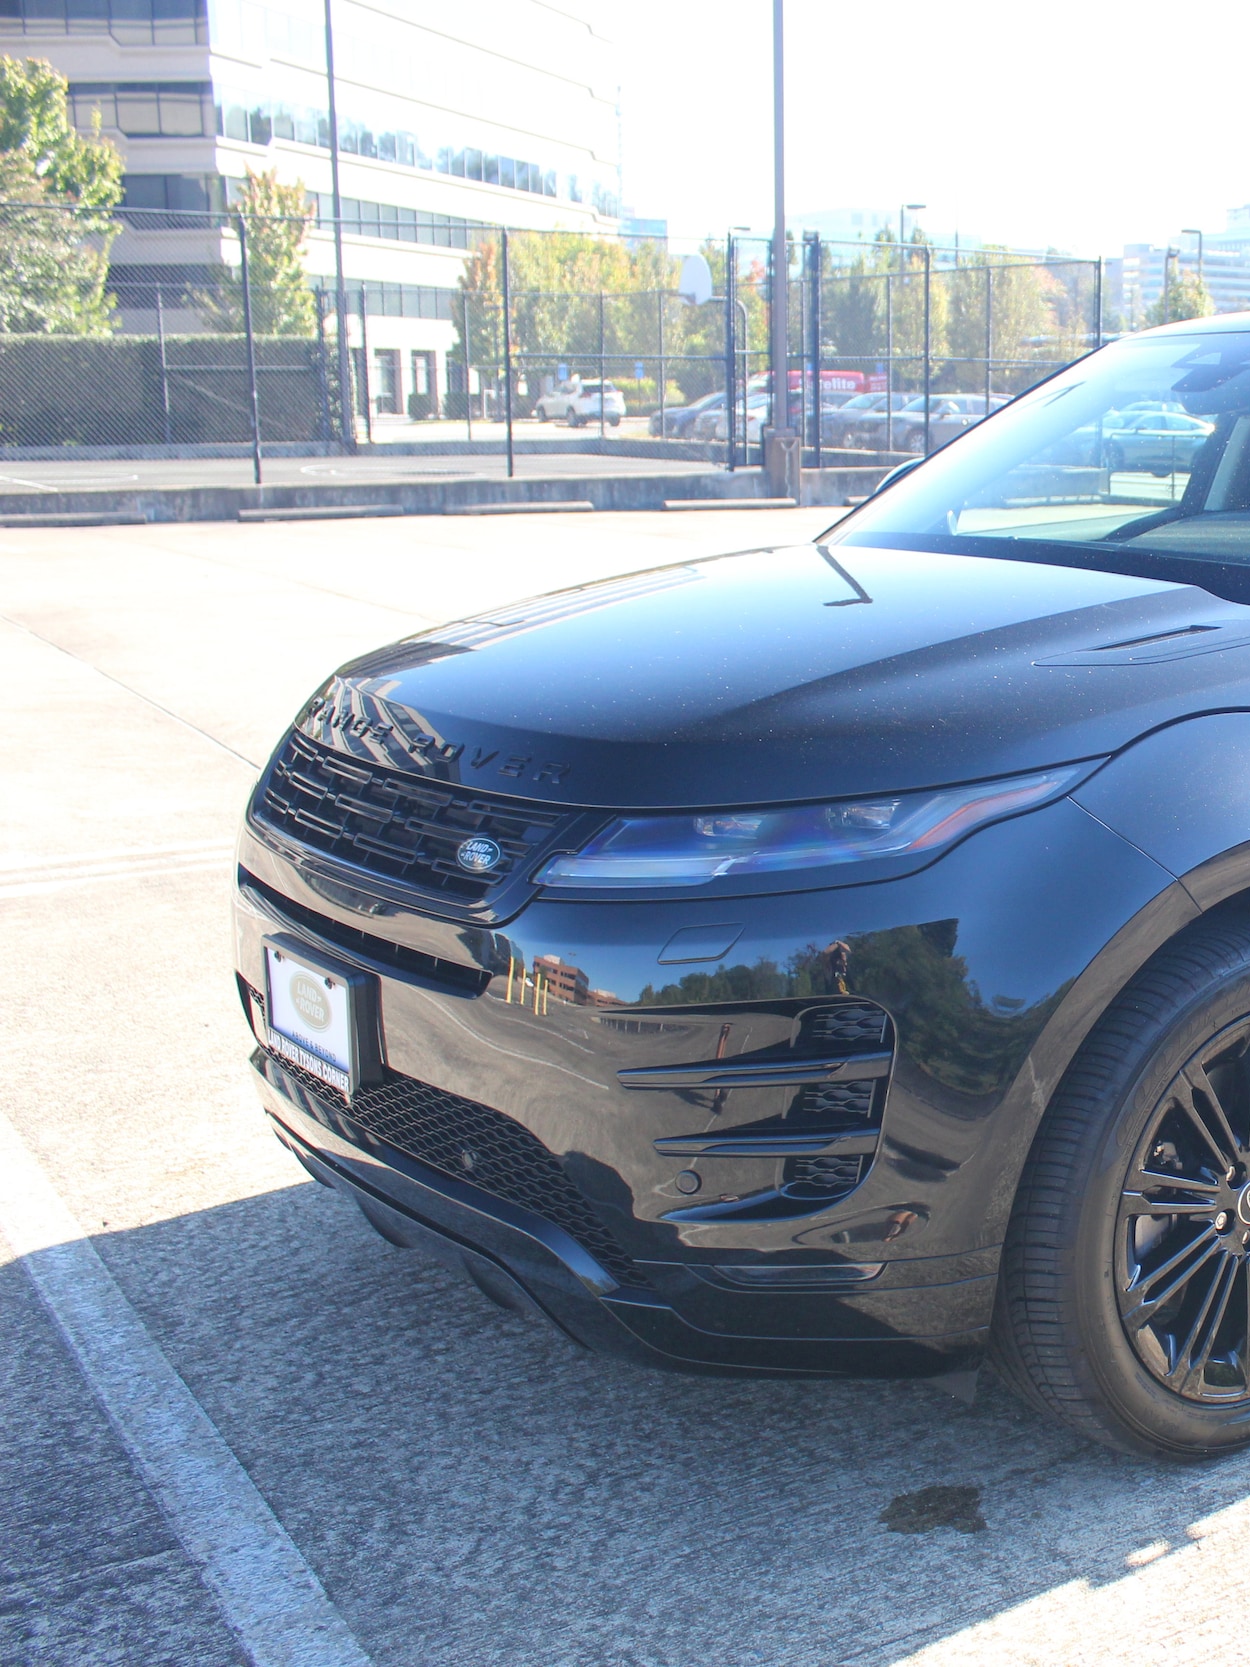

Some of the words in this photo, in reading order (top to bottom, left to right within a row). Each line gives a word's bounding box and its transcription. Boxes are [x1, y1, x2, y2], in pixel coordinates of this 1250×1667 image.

[308, 697, 394, 745] RANGE
[408, 733, 572, 784] ROVER
[463, 851, 491, 865] ROVER
[466, 842, 489, 853] LAND
[297, 981, 317, 1003] LAND
[299, 998, 325, 1022] ROVER
[291, 1030, 309, 1047] ABOVE
[315, 1042, 337, 1062] BEYOND
[268, 1029, 281, 1051] LAND
[281, 1038, 299, 1062] ROVER
[300, 1050, 322, 1077] TYSONS
[323, 1063, 349, 1093] CORNER
